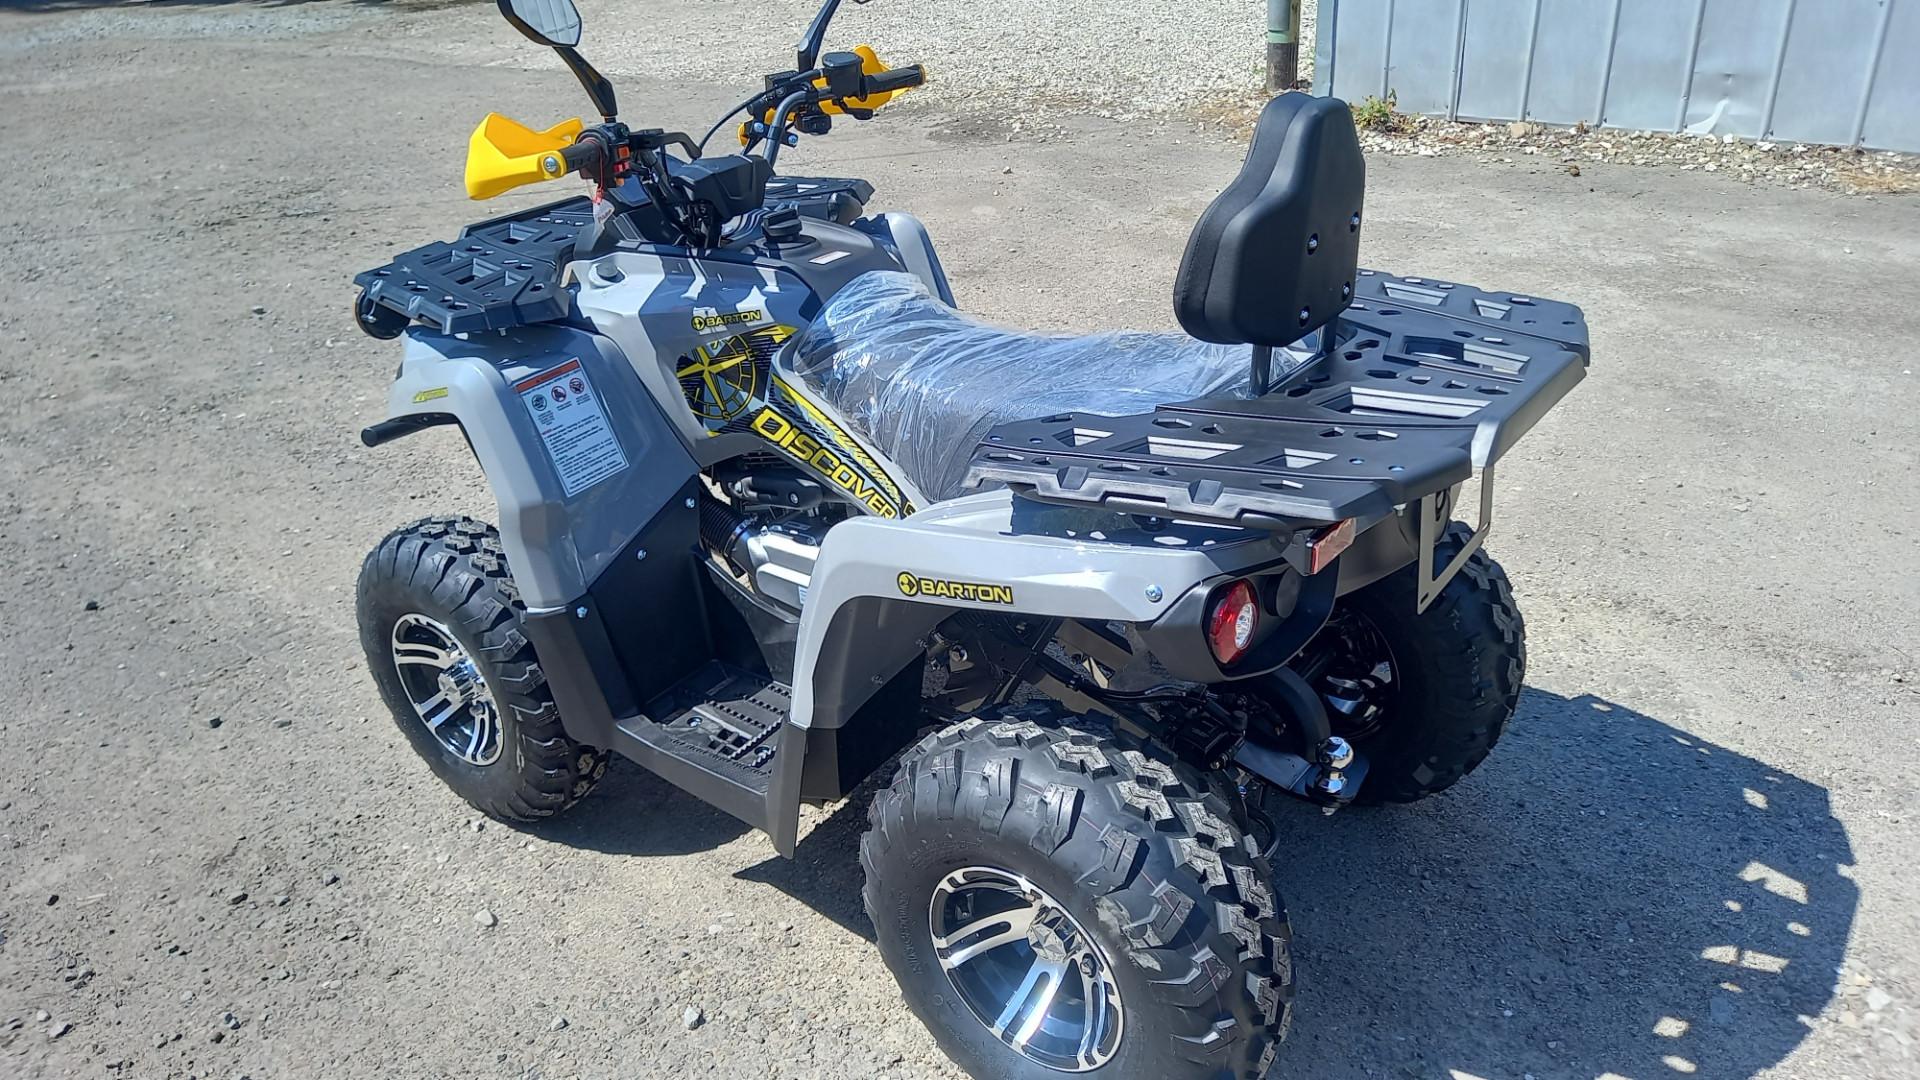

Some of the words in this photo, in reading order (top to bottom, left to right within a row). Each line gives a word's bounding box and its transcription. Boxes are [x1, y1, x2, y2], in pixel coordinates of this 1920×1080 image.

[705, 309, 761, 328] BARTON
[750, 406, 897, 519] DISCOVER
[919, 578, 1014, 604] BARTON
